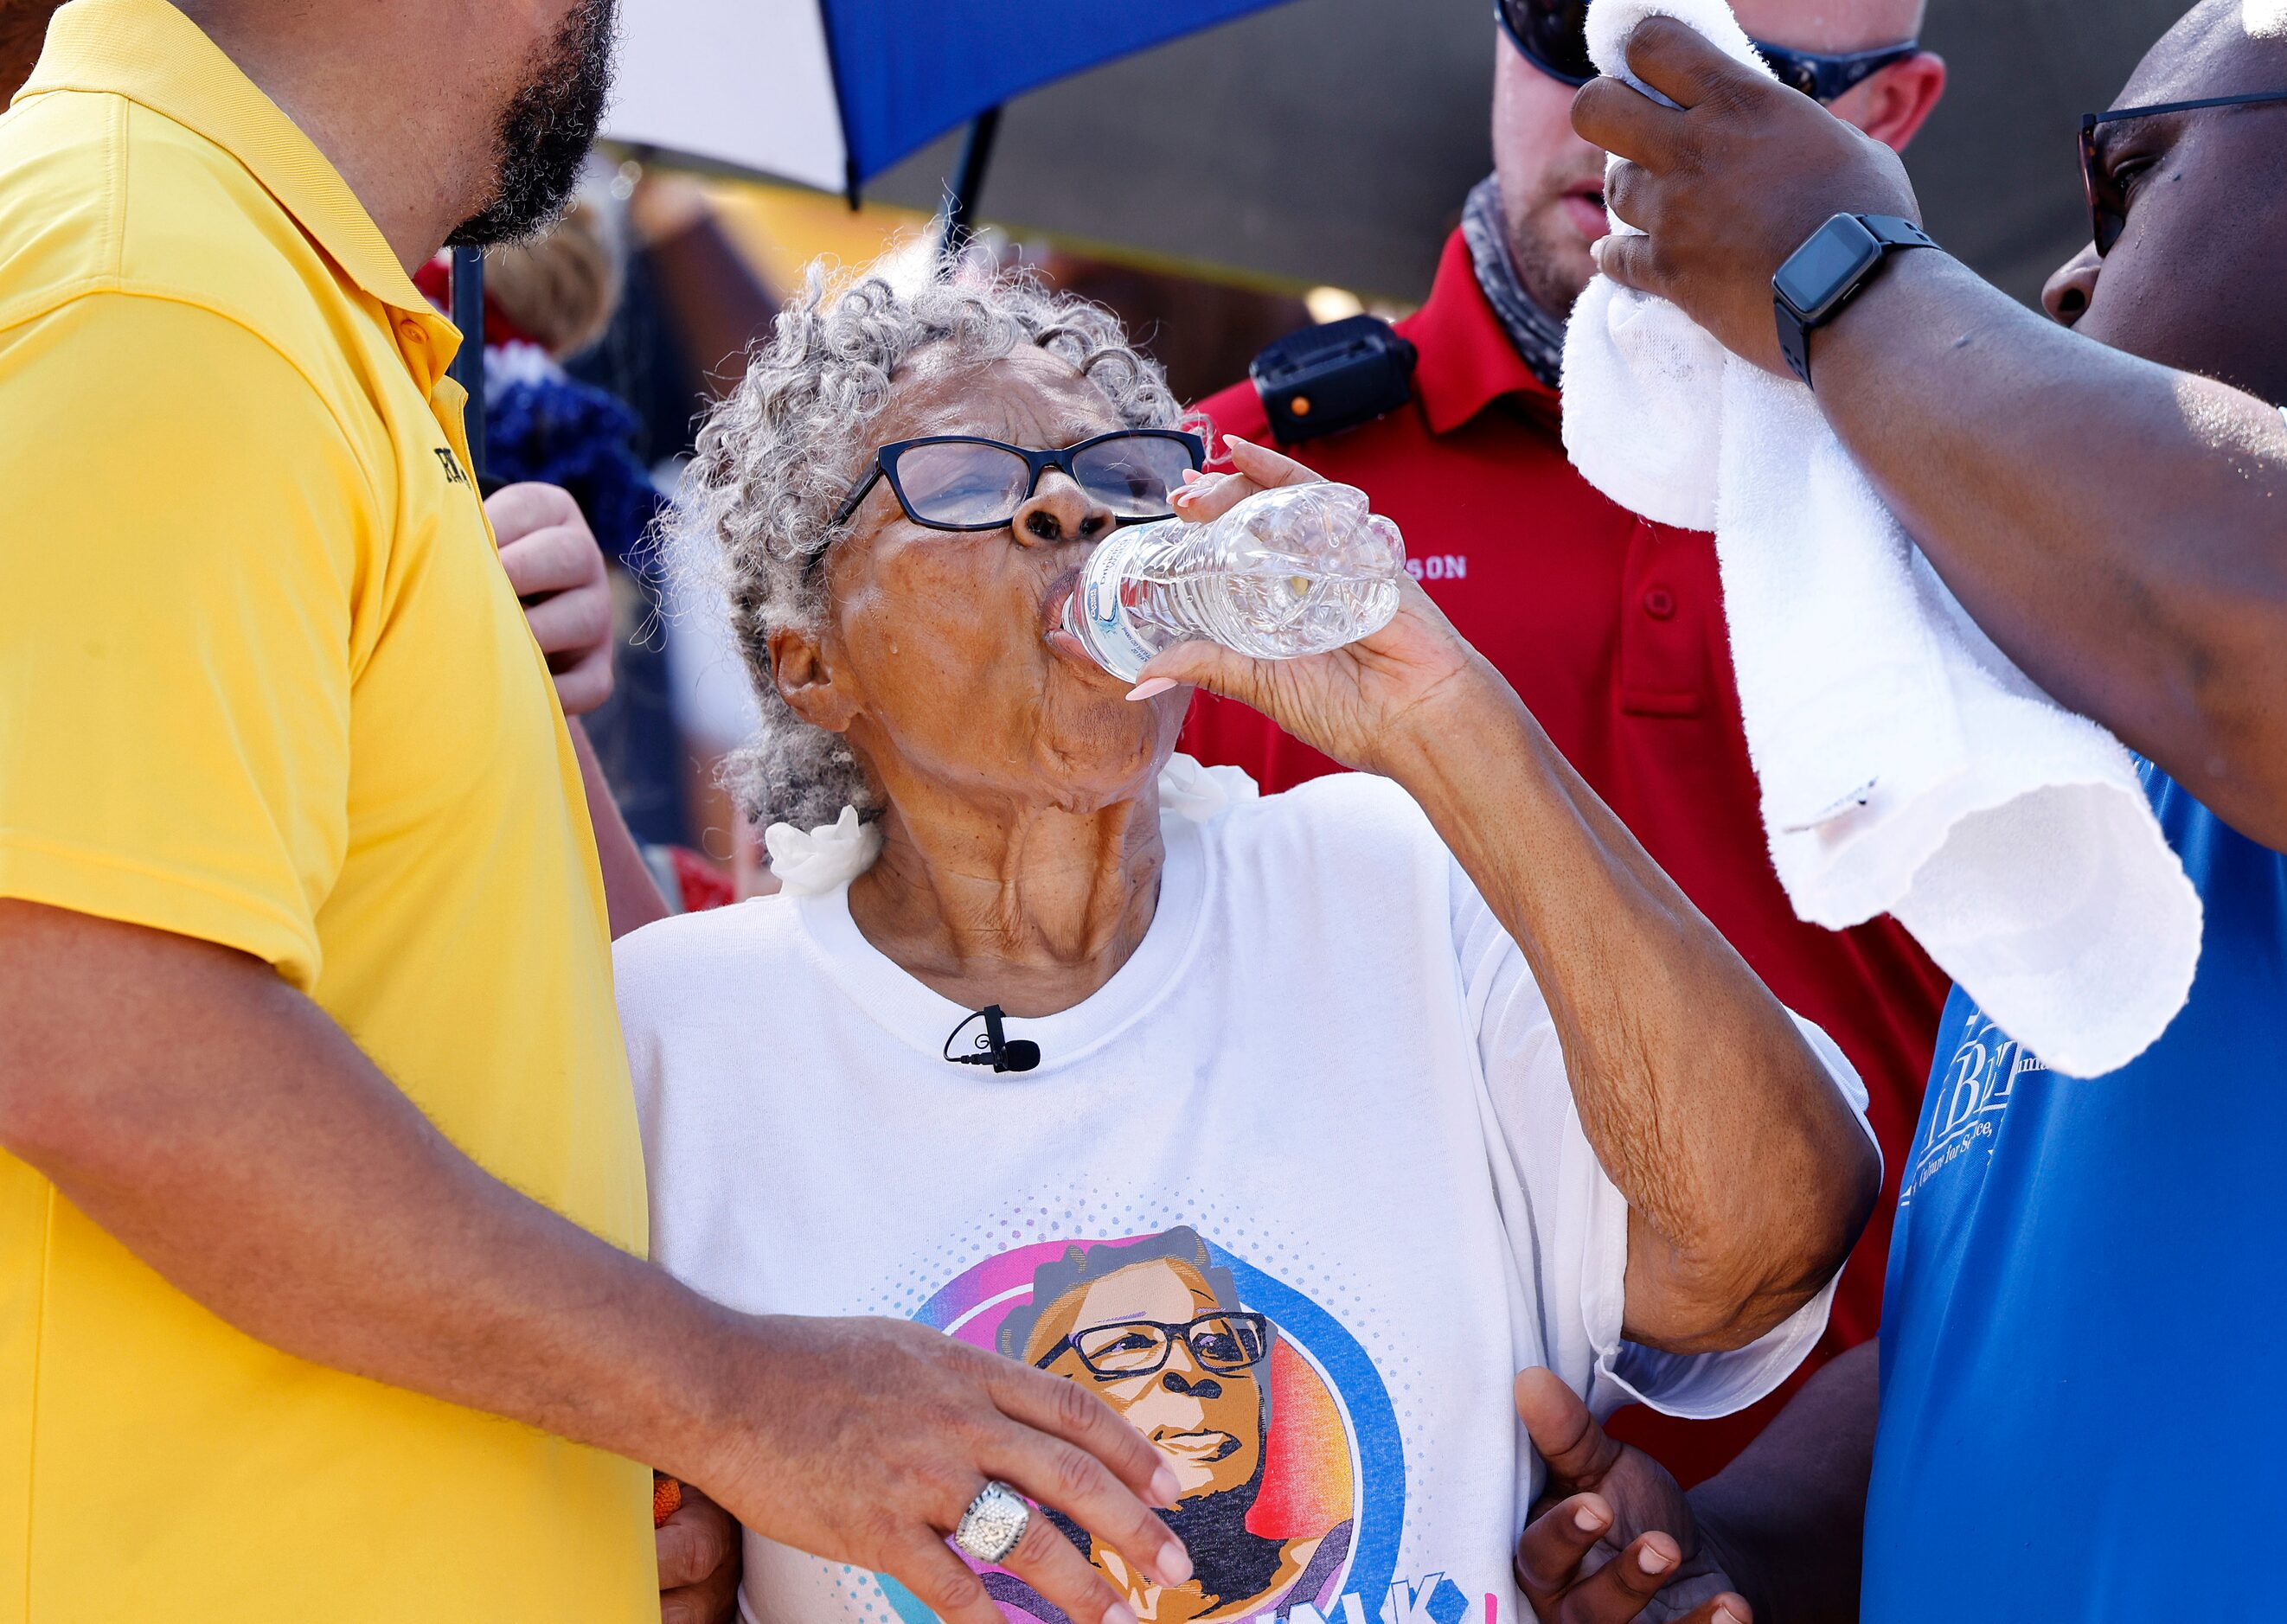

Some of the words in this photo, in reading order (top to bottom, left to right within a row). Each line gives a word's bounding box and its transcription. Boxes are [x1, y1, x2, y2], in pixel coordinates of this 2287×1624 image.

[1099, 539, 1129, 585] Drinking
[1406, 554, 1467, 581] SON
[1919, 1154, 1945, 1187] Culture
[1944, 1144, 1961, 1164] for
[1959, 1121, 1993, 1154] Seice,
